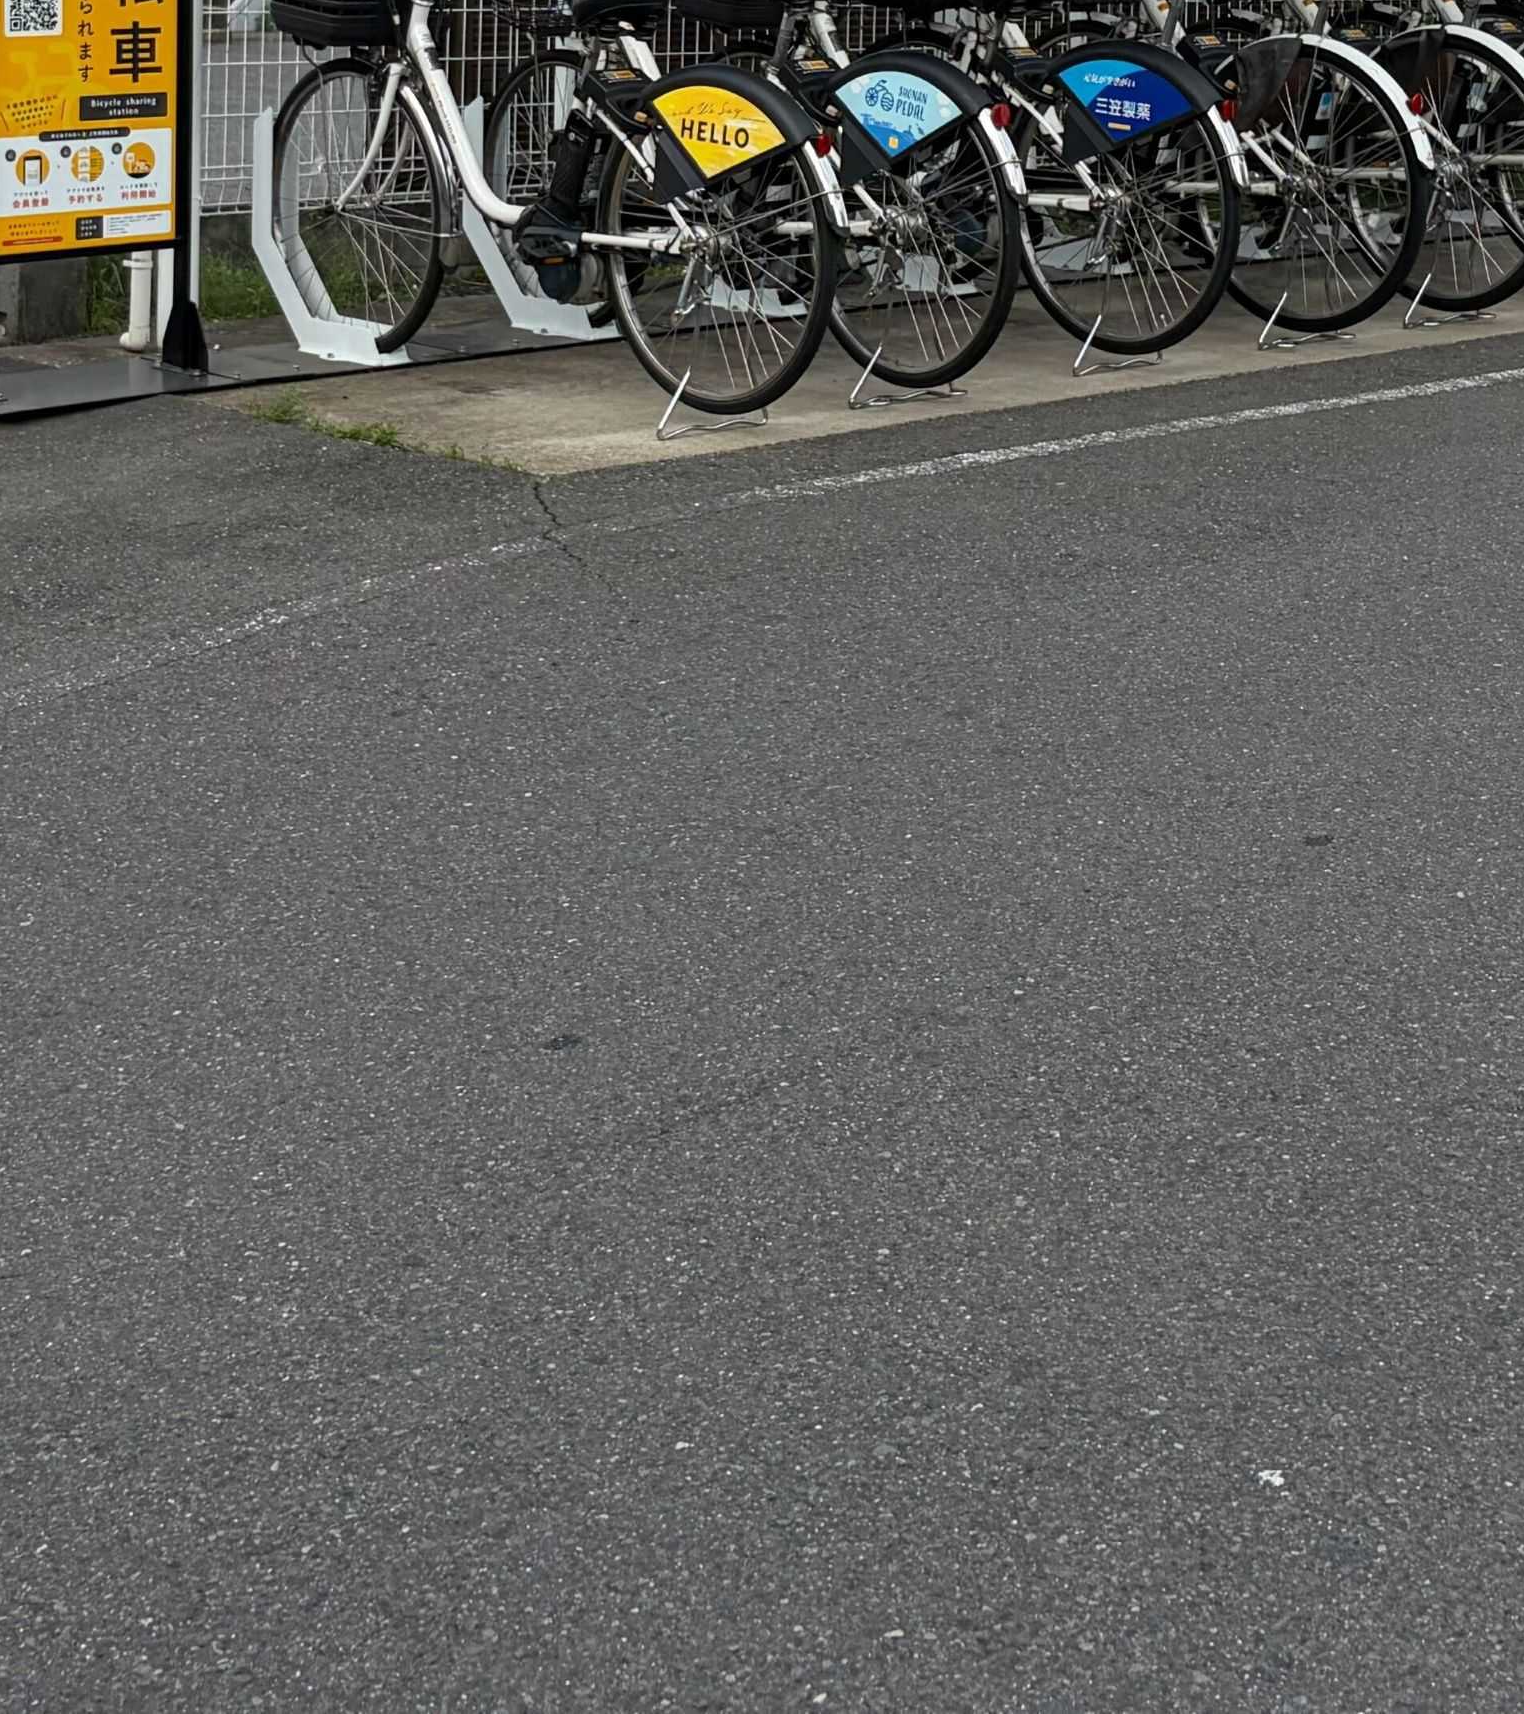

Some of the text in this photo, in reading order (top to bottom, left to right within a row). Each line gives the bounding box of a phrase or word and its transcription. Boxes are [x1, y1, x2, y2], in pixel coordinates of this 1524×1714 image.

[90, 96, 157, 108] Bicycle sharing
[108, 107, 139, 117] station
[896, 99, 925, 122] PEDAL
[1095, 97, 1151, 121] 三笠製薬
[680, 118, 750, 148] HELLO
